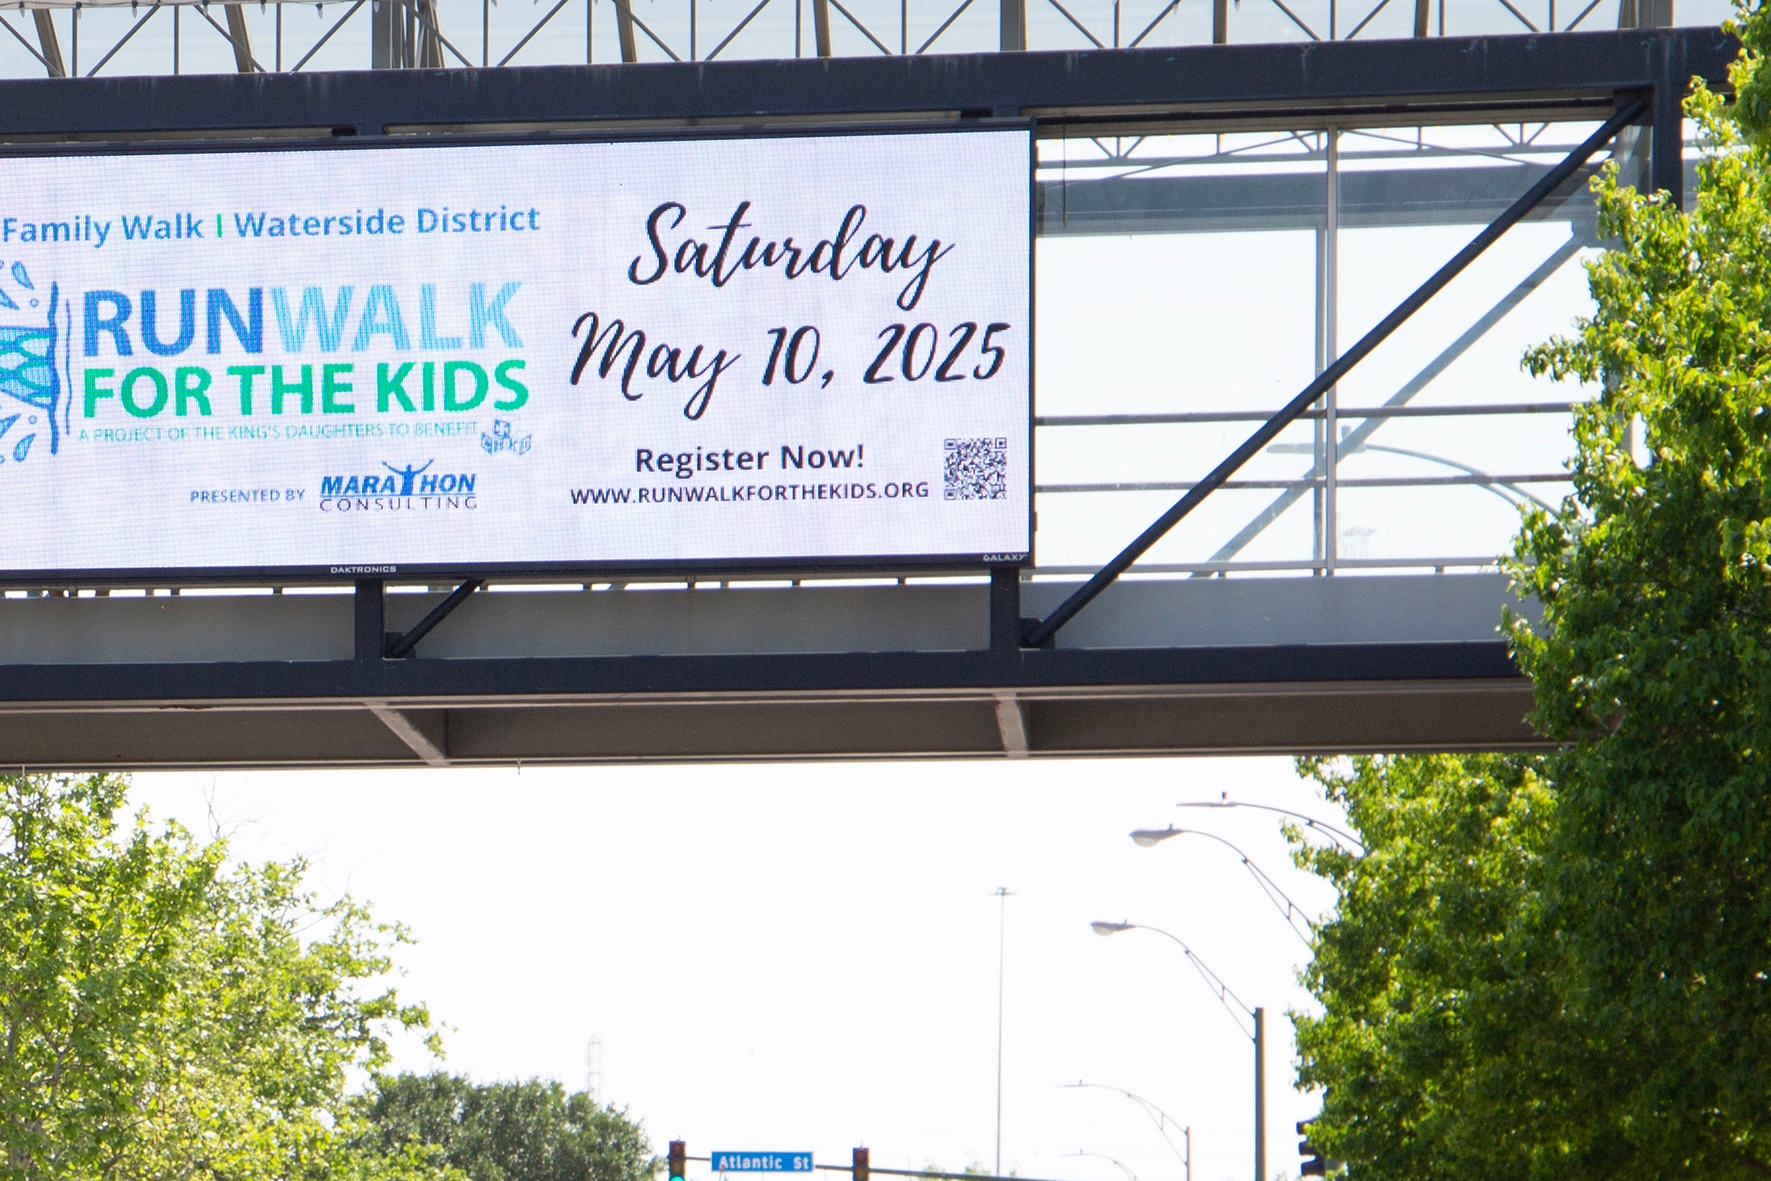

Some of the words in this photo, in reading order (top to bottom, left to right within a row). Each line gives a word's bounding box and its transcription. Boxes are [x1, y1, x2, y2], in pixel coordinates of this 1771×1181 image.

[3, 215, 111, 249] Family
[121, 212, 206, 241] Walk
[235, 207, 405, 238] Waterside
[417, 205, 541, 233] District
[628, 200, 955, 311] Saturday
[570, 311, 742, 421] May
[761, 325, 835, 389] 10,
[863, 321, 1012, 384] 2025
[83, 365, 212, 419] FOR
[227, 362, 356, 416] THE
[377, 358, 530, 414] KIDS
[78, 429, 89, 441] A
[94, 427, 163, 442] PROJECT
[168, 427, 188, 441] OF
[194, 425, 223, 440] THE
[228, 424, 281, 440] KING'S
[286, 422, 384, 439] DAUGHTERS
[387, 422, 410, 437] TO
[415, 421, 478, 436] BENEFIT
[635, 446, 770, 479] Register
[781, 443, 865, 470] Now!
[320, 467, 477, 495] MARATHON
[570, 480, 930, 505] WWW.RUNWALKFORTHEKIDS.ORG
[189, 489, 281, 503] PRESENTED
[285, 488, 305, 502] BY
[319, 496, 478, 512] CONSULTING
[330, 565, 397, 574] DAKTRONICS
[982, 553, 1026, 562] GALAXY
[718, 1155, 783, 1170] Atlantic
[793, 1156, 810, 1170] St
